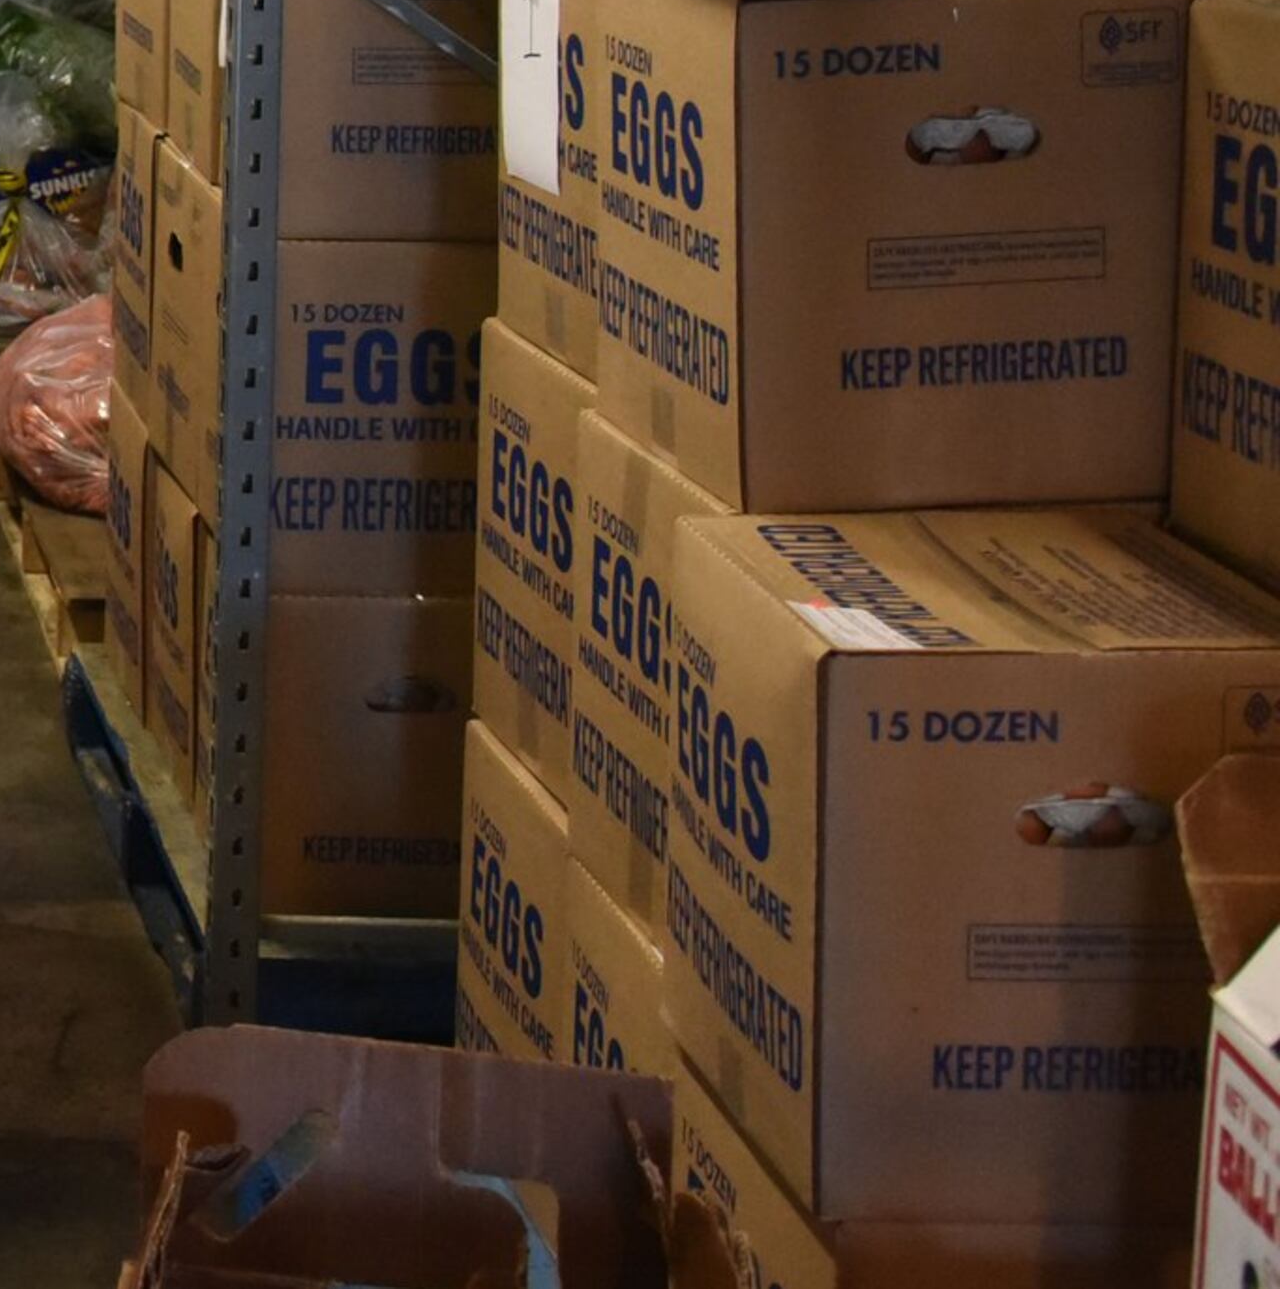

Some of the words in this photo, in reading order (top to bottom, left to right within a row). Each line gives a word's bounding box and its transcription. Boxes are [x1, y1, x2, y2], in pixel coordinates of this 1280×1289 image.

[617, 40, 653, 78] DOZEN
[774, 49, 811, 78] 15
[822, 43, 941, 77] DOZEN
[332, 126, 382, 153] KEEP
[611, 71, 703, 211] EGGS
[602, 179, 646, 233] HANDLE
[648, 202, 682, 252] WITH
[685, 222, 720, 272] CARE
[323, 304, 405, 324] DOZEN
[628, 274, 729, 407] REFRIGERATED
[841, 345, 911, 391] KEEP
[917, 334, 1127, 387] REFRIGERATED
[277, 416, 383, 441] HANDLE
[391, 417, 461, 441] WITH
[271, 477, 336, 531] KEEP
[492, 427, 574, 573] EGGS
[868, 710, 909, 742] 15
[924, 710, 1060, 743] DOZEN
[678, 660, 771, 862] EGGS
[471, 833, 543, 999] EGGS
[746, 871, 792, 944] CARE
[933, 1045, 1012, 1090] KEEP
